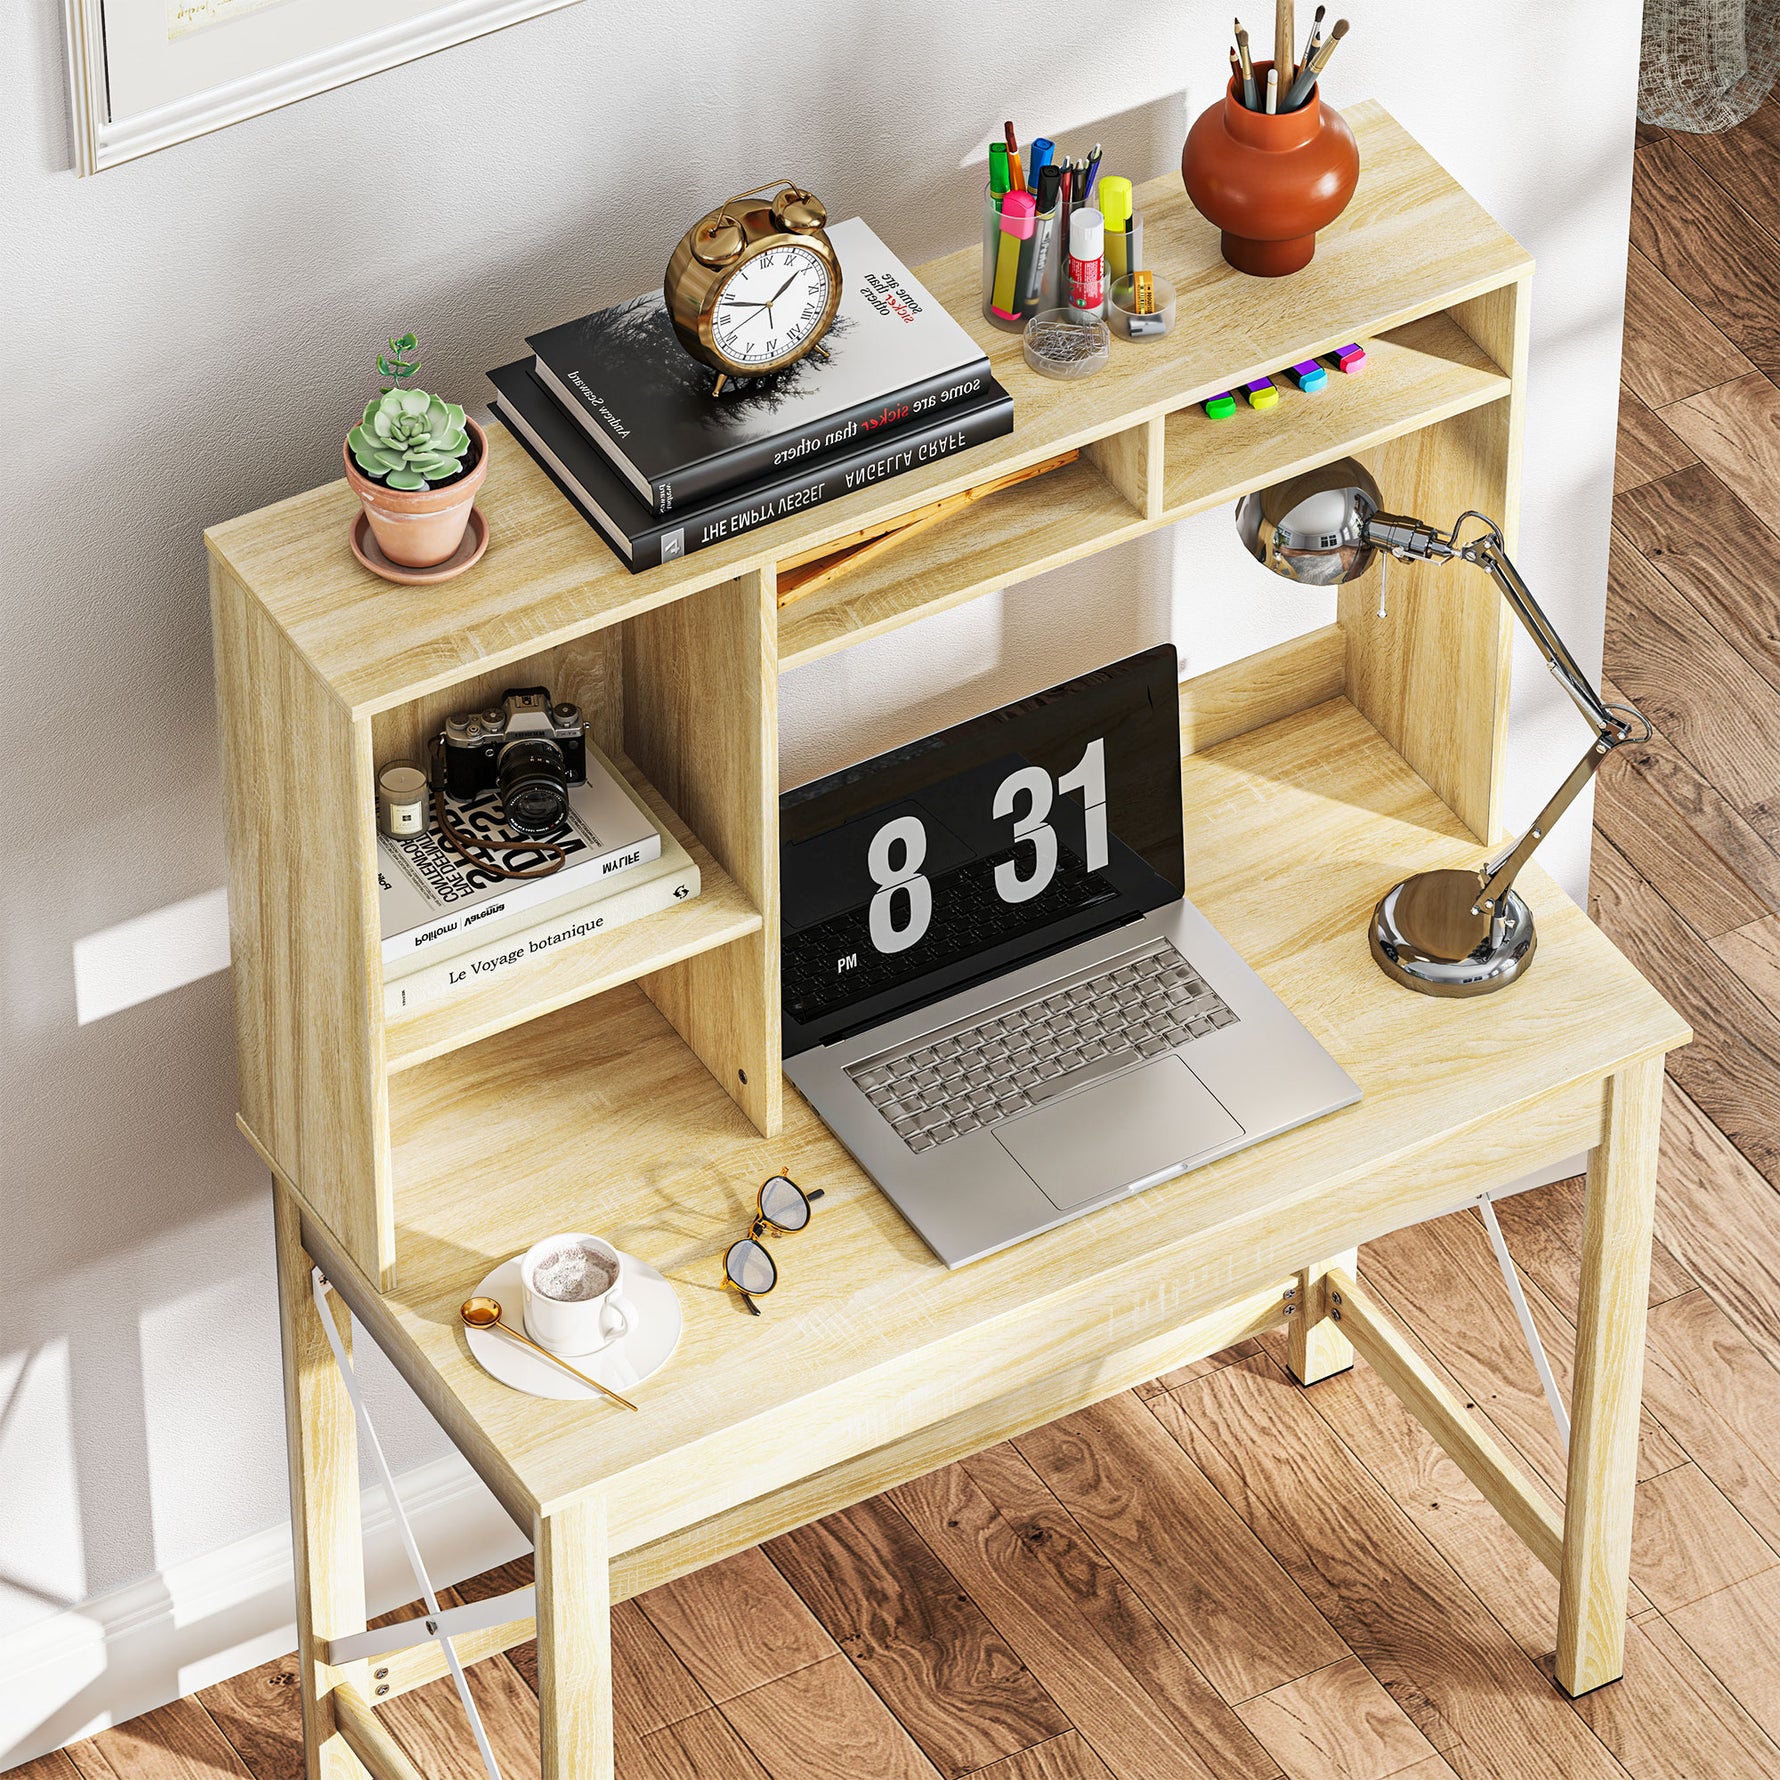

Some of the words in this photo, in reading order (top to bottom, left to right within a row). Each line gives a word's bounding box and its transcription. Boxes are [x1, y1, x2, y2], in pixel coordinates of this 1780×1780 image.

[867, 815, 933, 955] 8
[992, 737, 1109, 904] 31
[449, 970, 467, 985] Le
[471, 948, 525, 975] Voyage
[528, 917, 604, 953] botanique
[837, 952, 858, 974] PM
